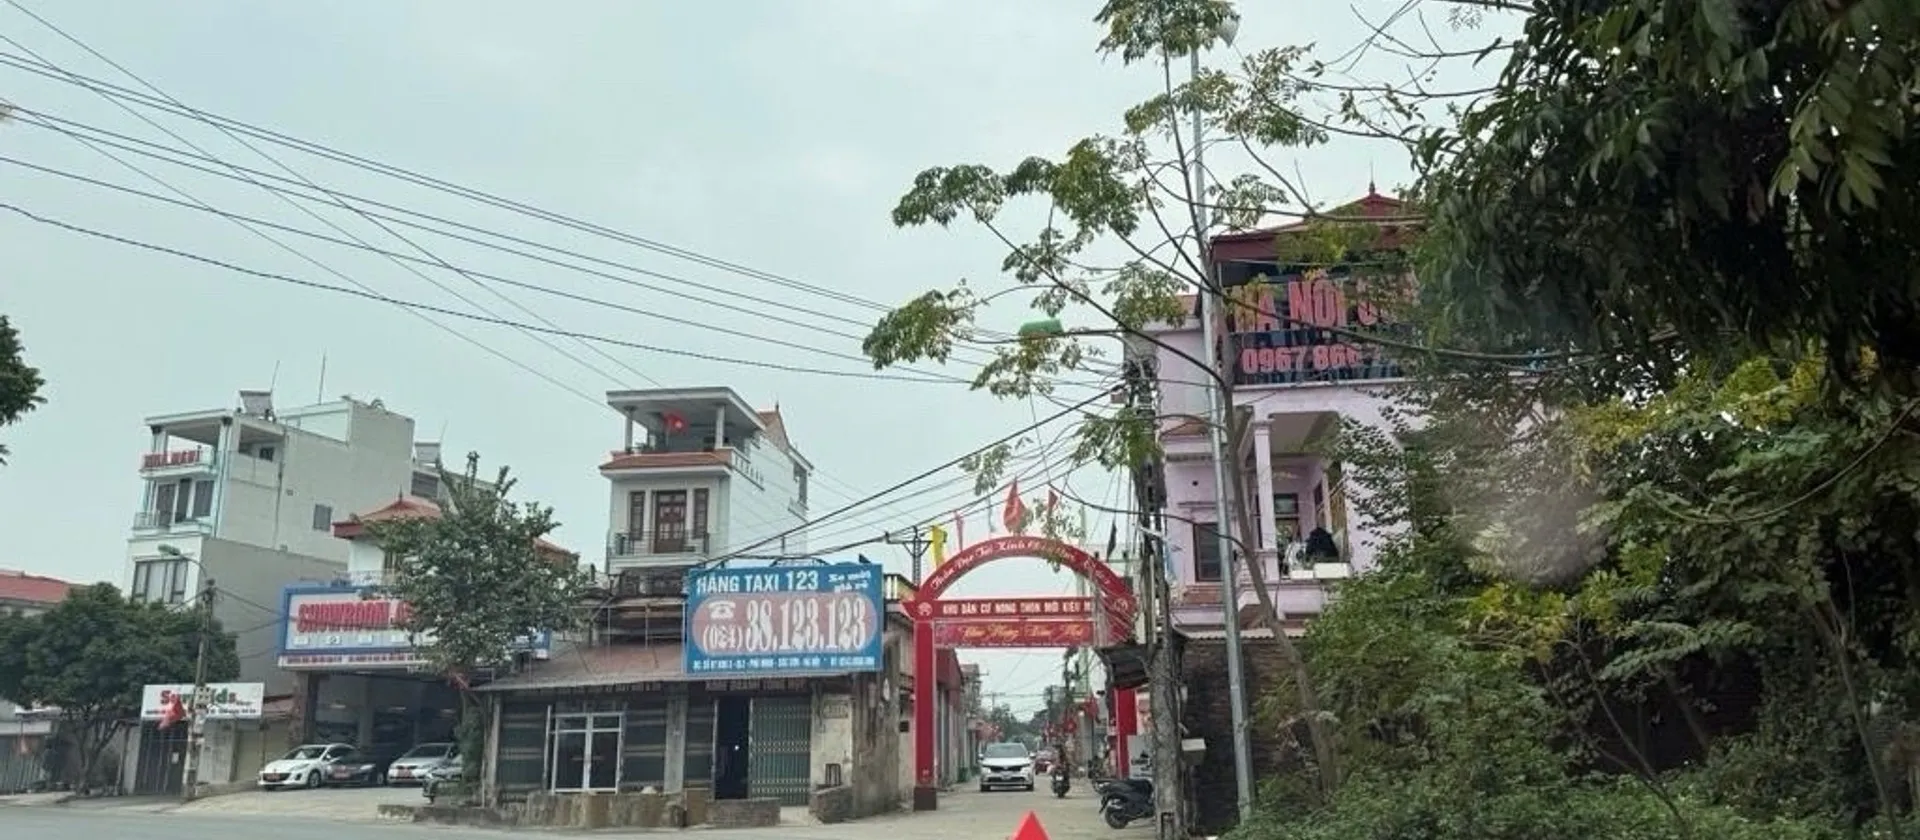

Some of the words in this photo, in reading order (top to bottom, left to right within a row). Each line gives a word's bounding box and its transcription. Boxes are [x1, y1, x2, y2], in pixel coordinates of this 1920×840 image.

[1241, 348, 1306, 374] 0967
[744, 575, 779, 592] TAXI
[786, 571, 818, 590] 123
